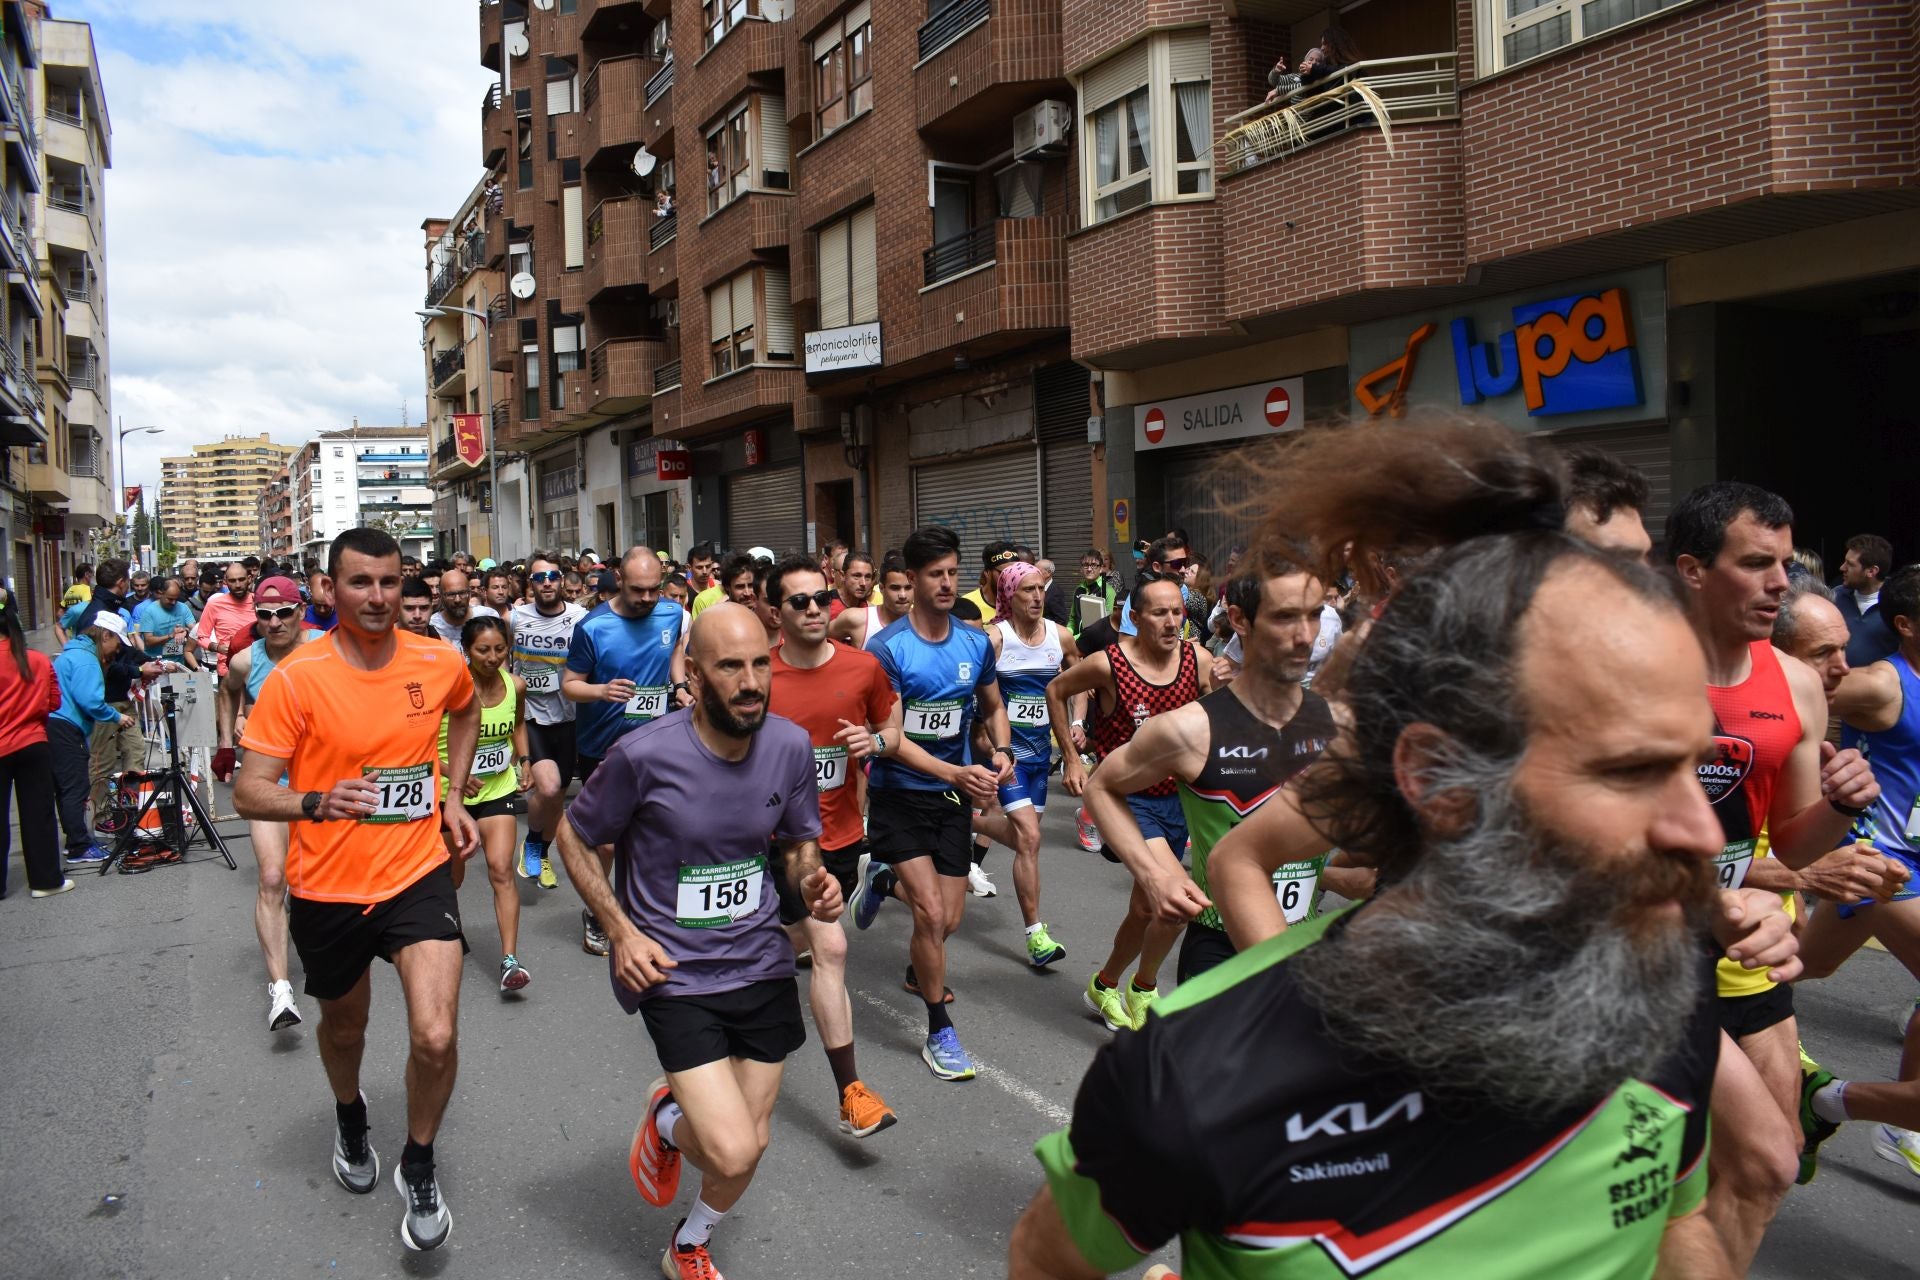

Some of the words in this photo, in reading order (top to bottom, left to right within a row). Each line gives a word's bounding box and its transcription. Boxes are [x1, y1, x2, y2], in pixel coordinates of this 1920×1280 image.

[1451, 288, 1634, 411] lupa
[1183, 402, 1243, 431] SALIDA
[526, 676, 550, 688] 302
[636, 696, 660, 710] 261
[1017, 704, 1044, 719] 245
[919, 712, 951, 729] 184
[478, 751, 504, 769] 260
[1697, 765, 1740, 777] ODOSA
[380, 781, 423, 809] 128
[702, 866, 730, 875] CARRERA
[732, 860, 756, 871] POPULAR
[699, 879, 748, 911] 158
[1289, 1153, 1390, 1183] Sakimóvil
